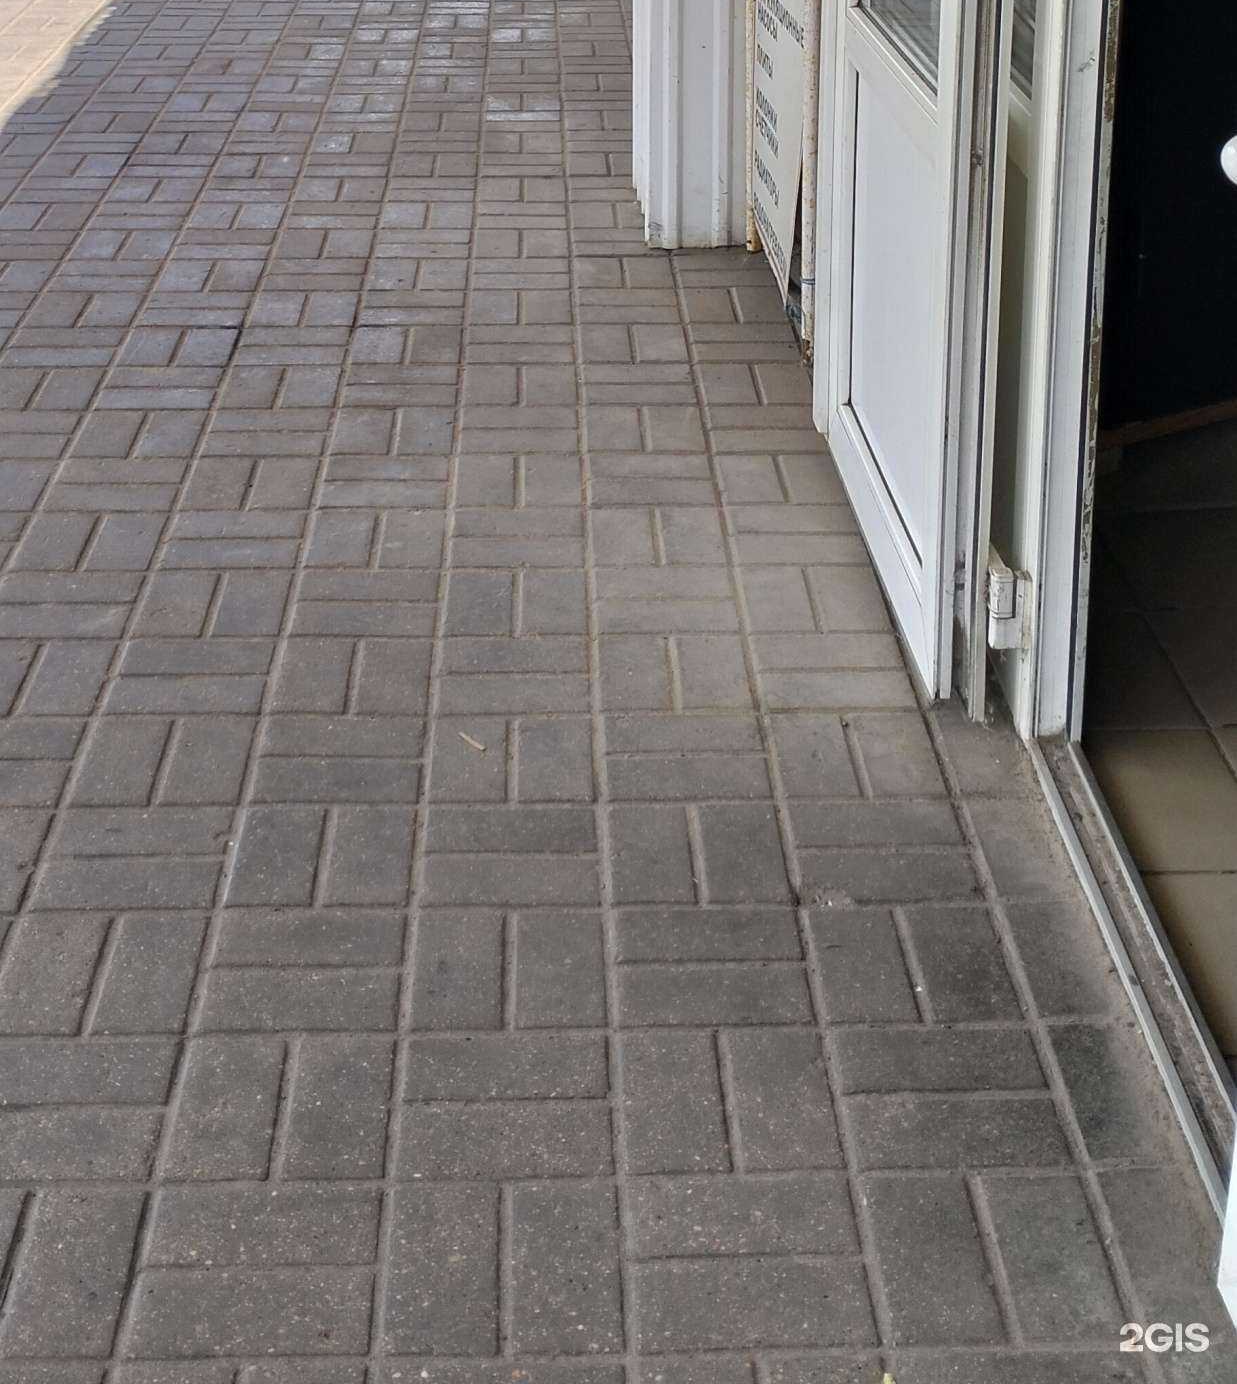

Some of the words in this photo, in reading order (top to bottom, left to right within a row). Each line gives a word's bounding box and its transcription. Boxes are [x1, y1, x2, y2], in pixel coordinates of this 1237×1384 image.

[757, 2, 778, 42] НАСОСЫ
[756, 43, 774, 80] ПЛИТЫ
[755, 86, 778, 134] КОЛОНКИ
[754, 149, 780, 209] РАДИАТОРЫ
